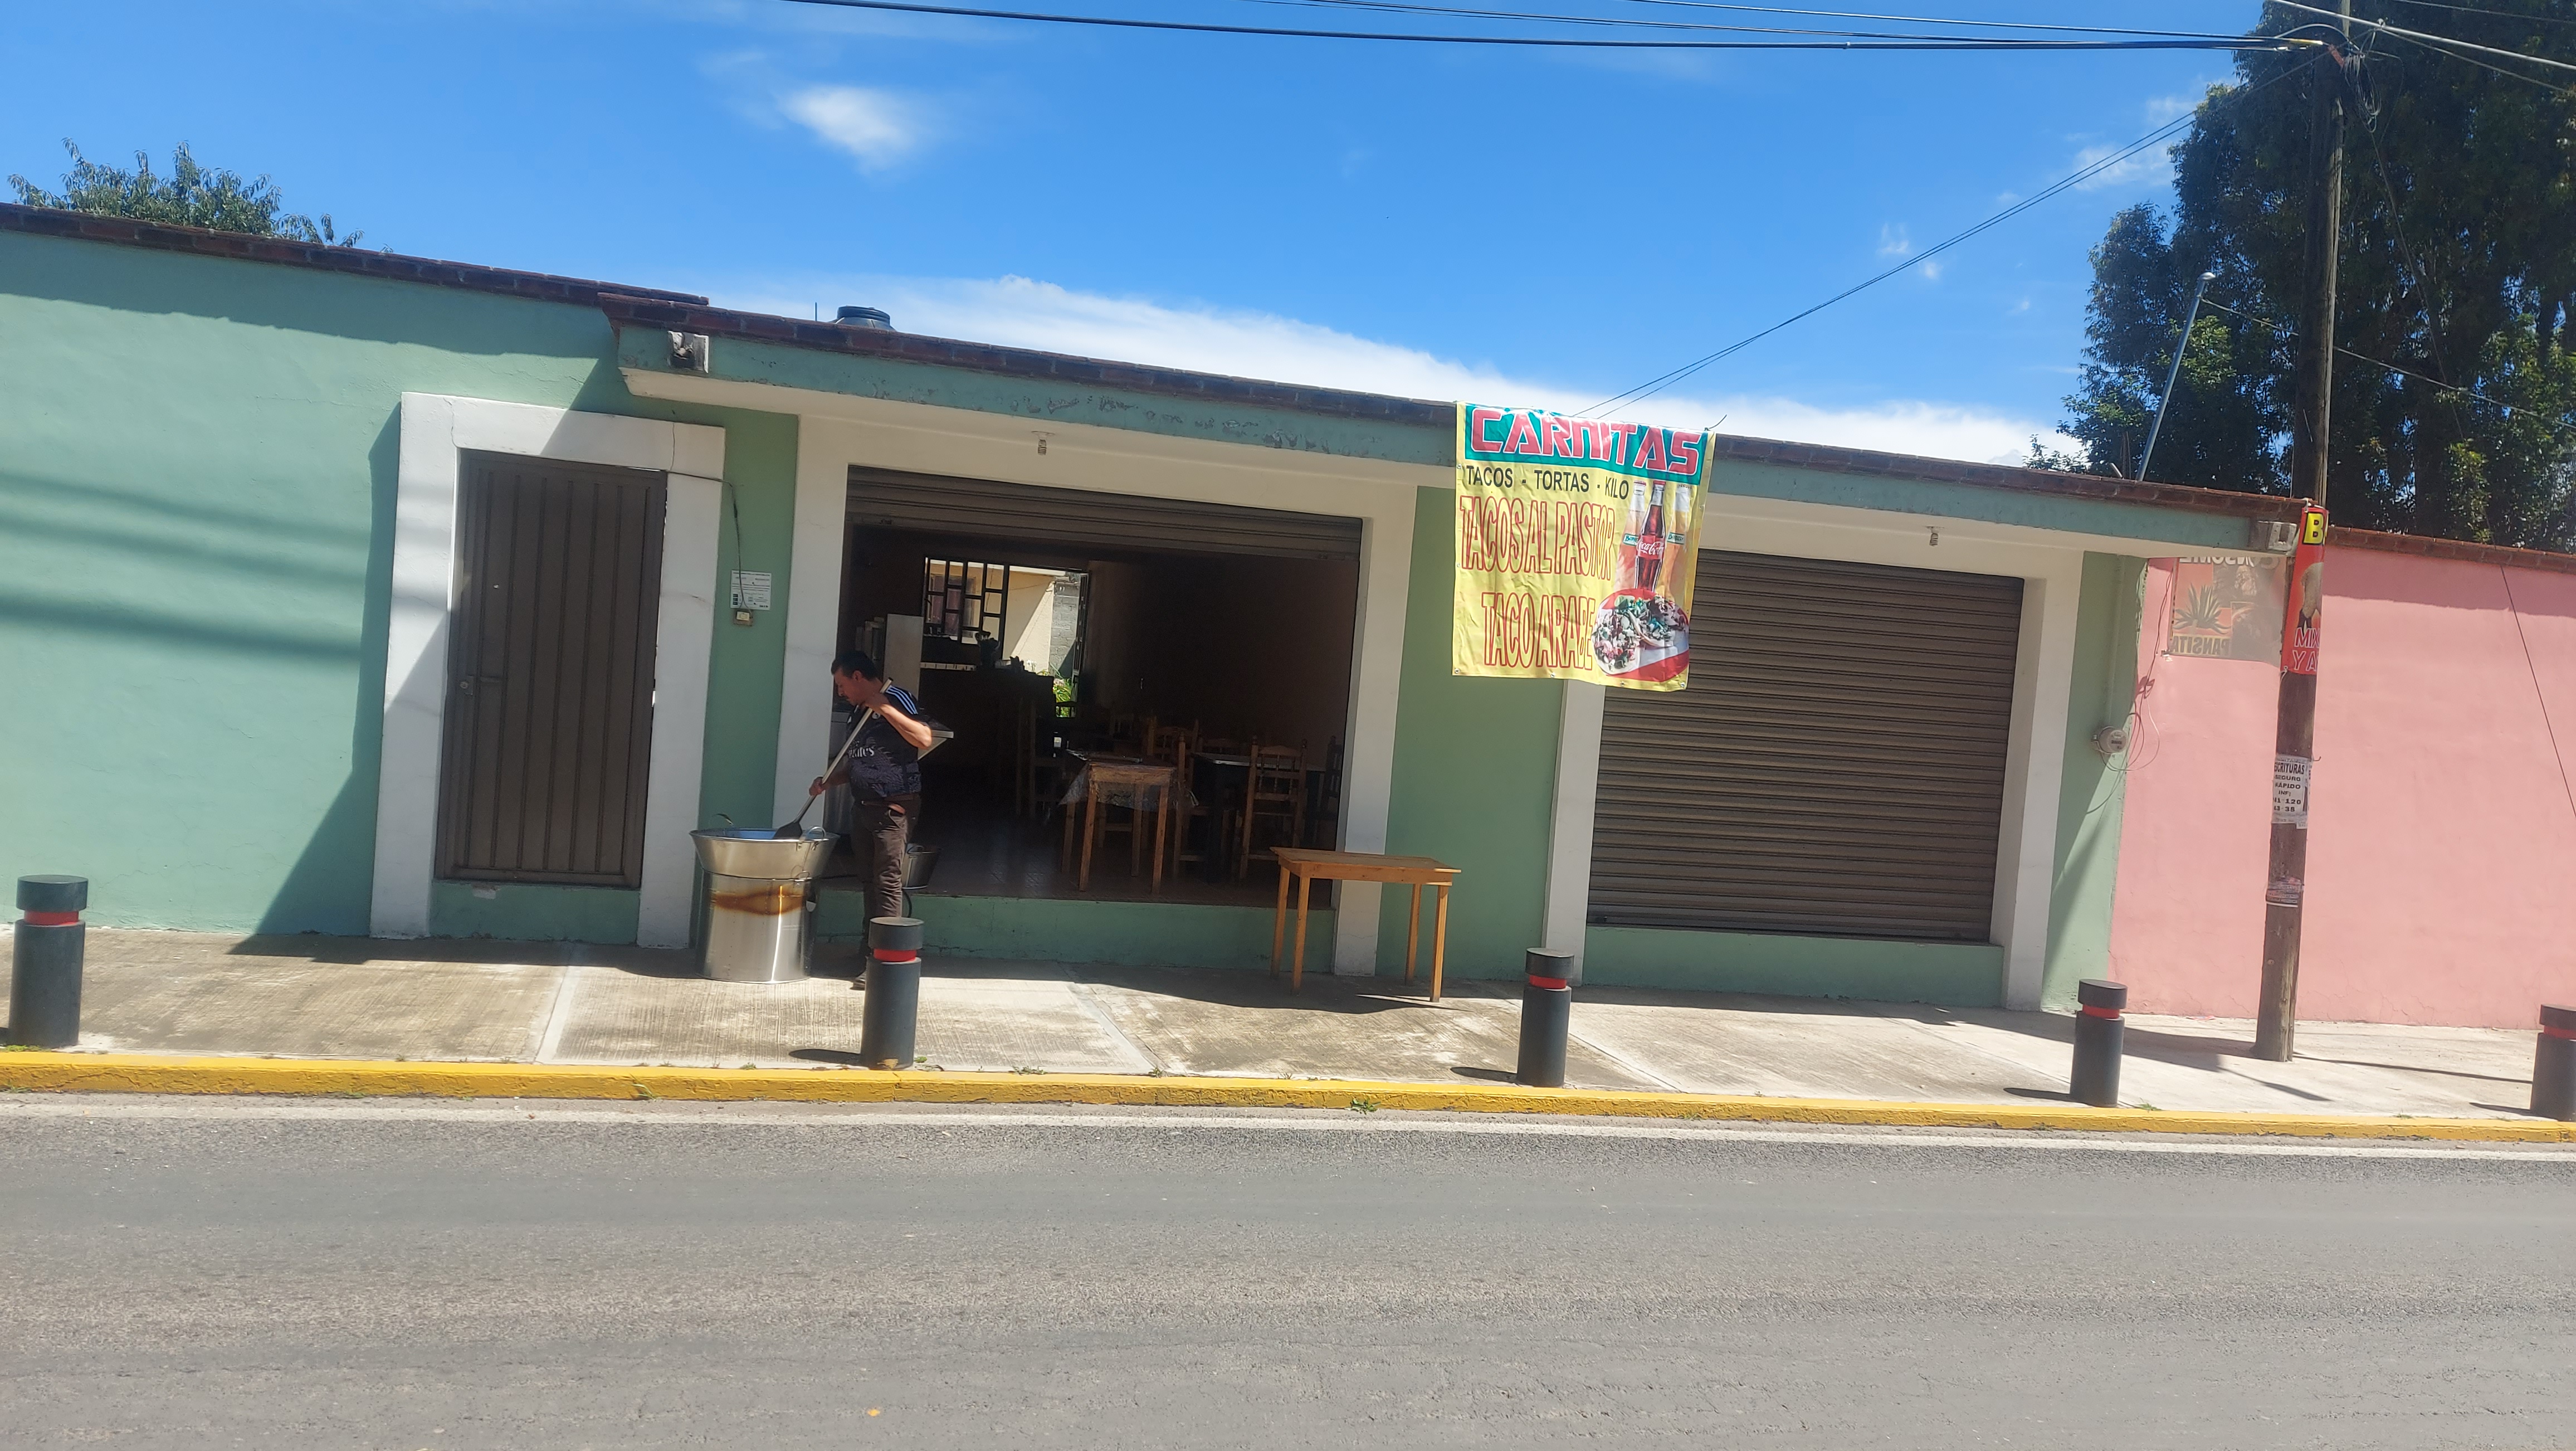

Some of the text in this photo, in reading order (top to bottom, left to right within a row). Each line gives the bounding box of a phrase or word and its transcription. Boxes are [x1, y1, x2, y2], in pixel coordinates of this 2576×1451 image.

[1471, 408, 1702, 475] CARNITAS
[1466, 465, 1514, 488] TACOS
[1534, 469, 1589, 492] TORTAS
[1604, 475, 1629, 500] KILO
[1460, 495, 1615, 581] TACOS AL PASTOR
[2302, 512, 2328, 546] B
[1481, 592, 1596, 671] TACO ARABE
[2292, 650, 2319, 671] Y A
